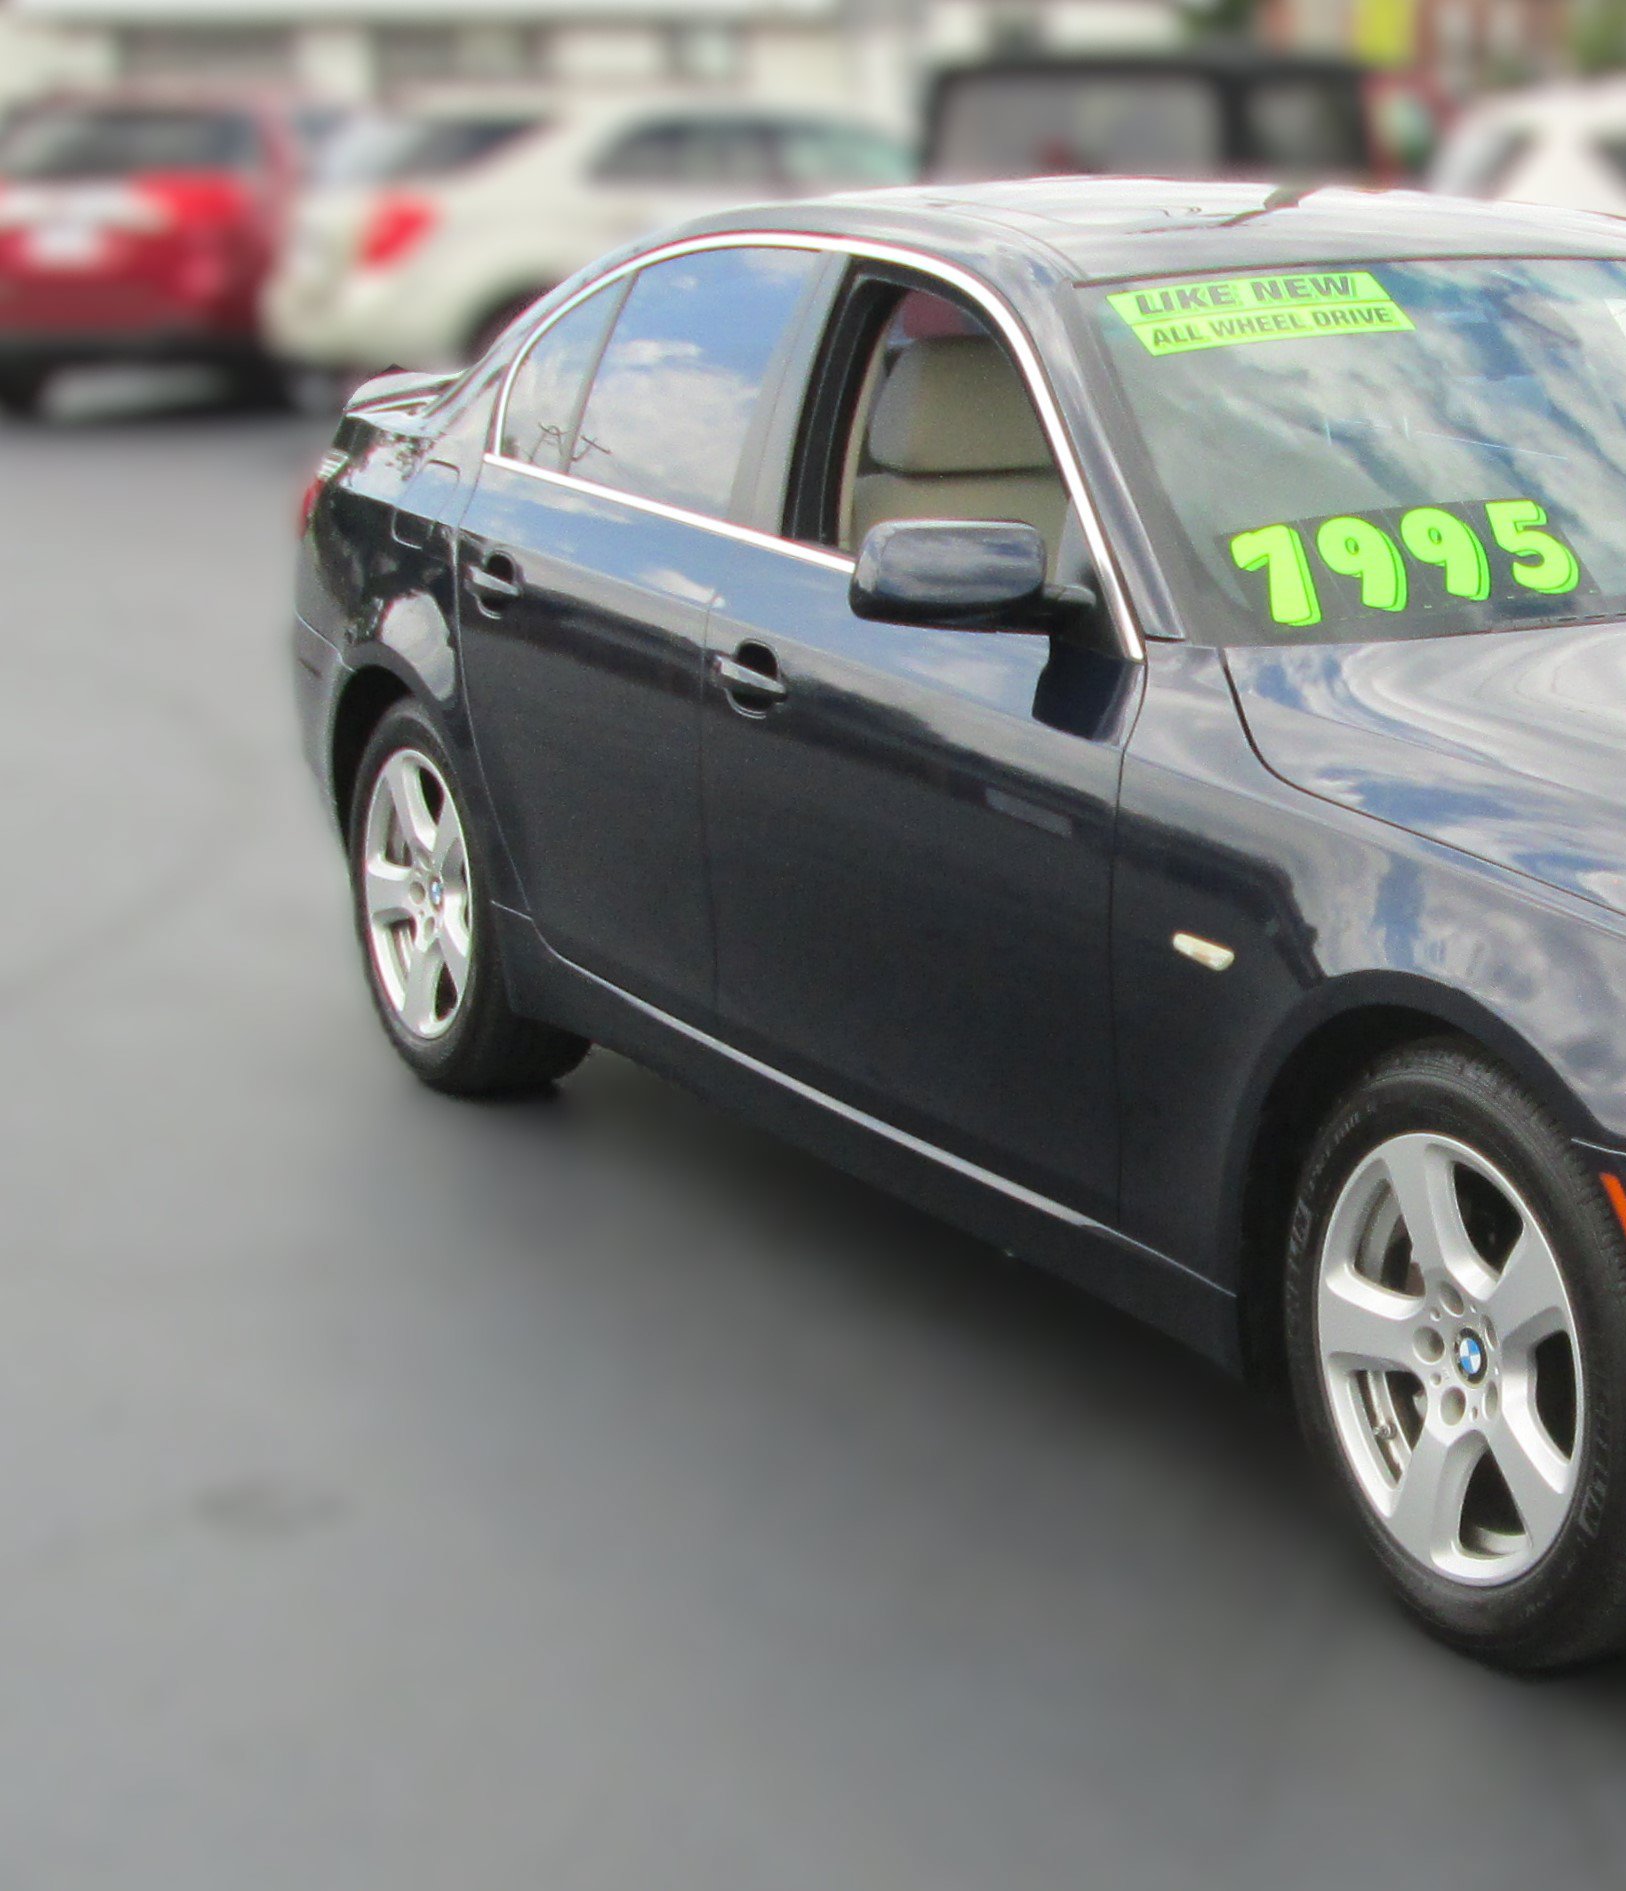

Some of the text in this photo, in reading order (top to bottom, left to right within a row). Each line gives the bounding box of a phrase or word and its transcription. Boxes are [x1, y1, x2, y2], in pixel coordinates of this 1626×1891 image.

[1135, 284, 1237, 315] LIKE
[1153, 307, 1393, 347] ALL WHEEL DRIVE
[1230, 500, 1580, 627] 7995
